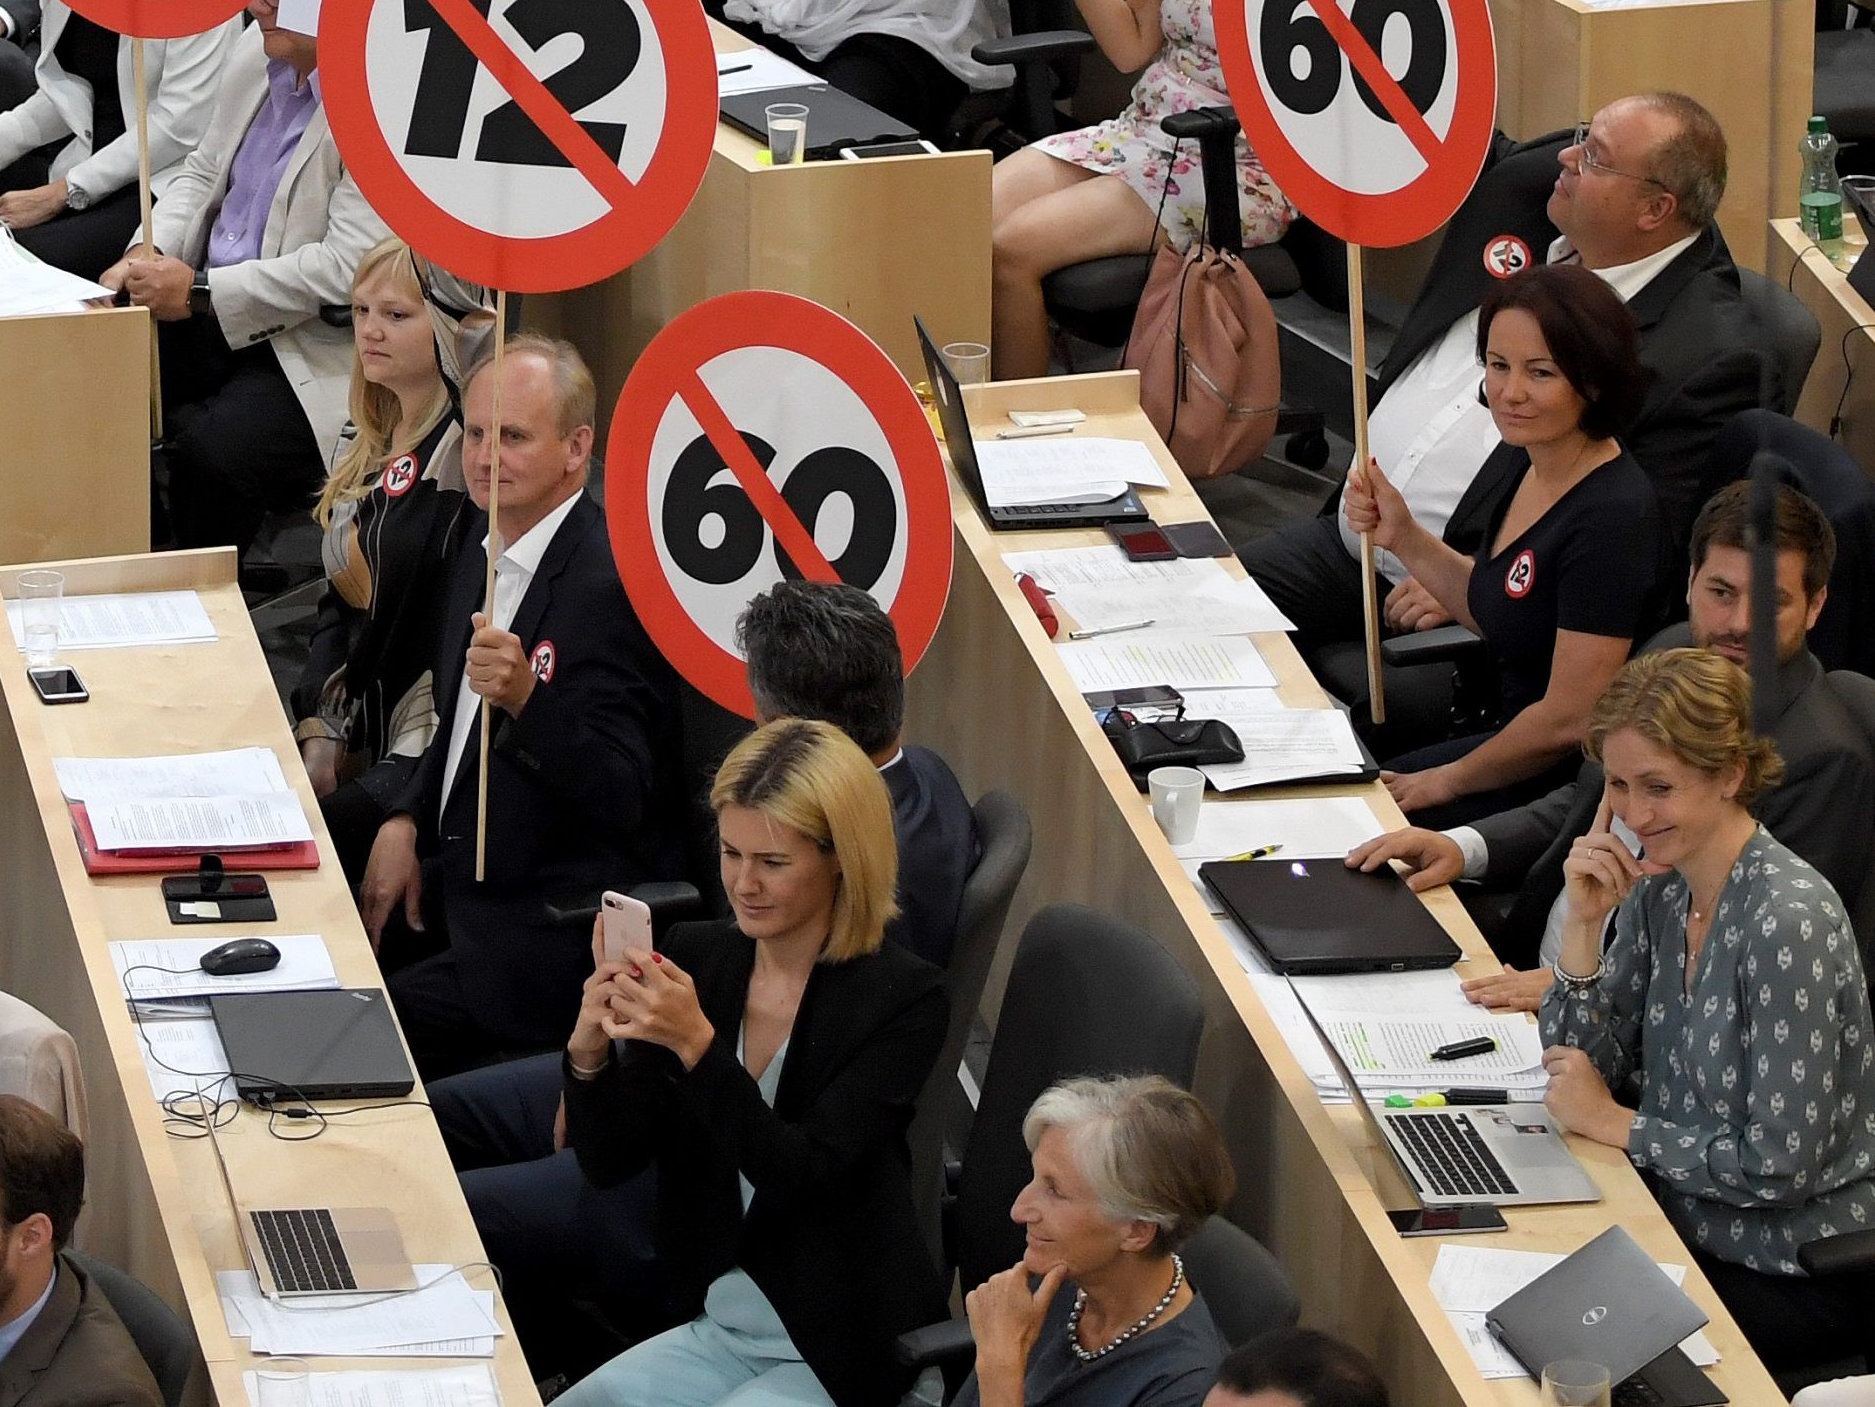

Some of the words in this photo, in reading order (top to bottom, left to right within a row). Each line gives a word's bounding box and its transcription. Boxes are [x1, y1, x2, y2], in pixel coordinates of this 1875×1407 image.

[392, 460, 413, 487] 12
[662, 431, 896, 594] 60
[1509, 564, 1530, 587] 12
